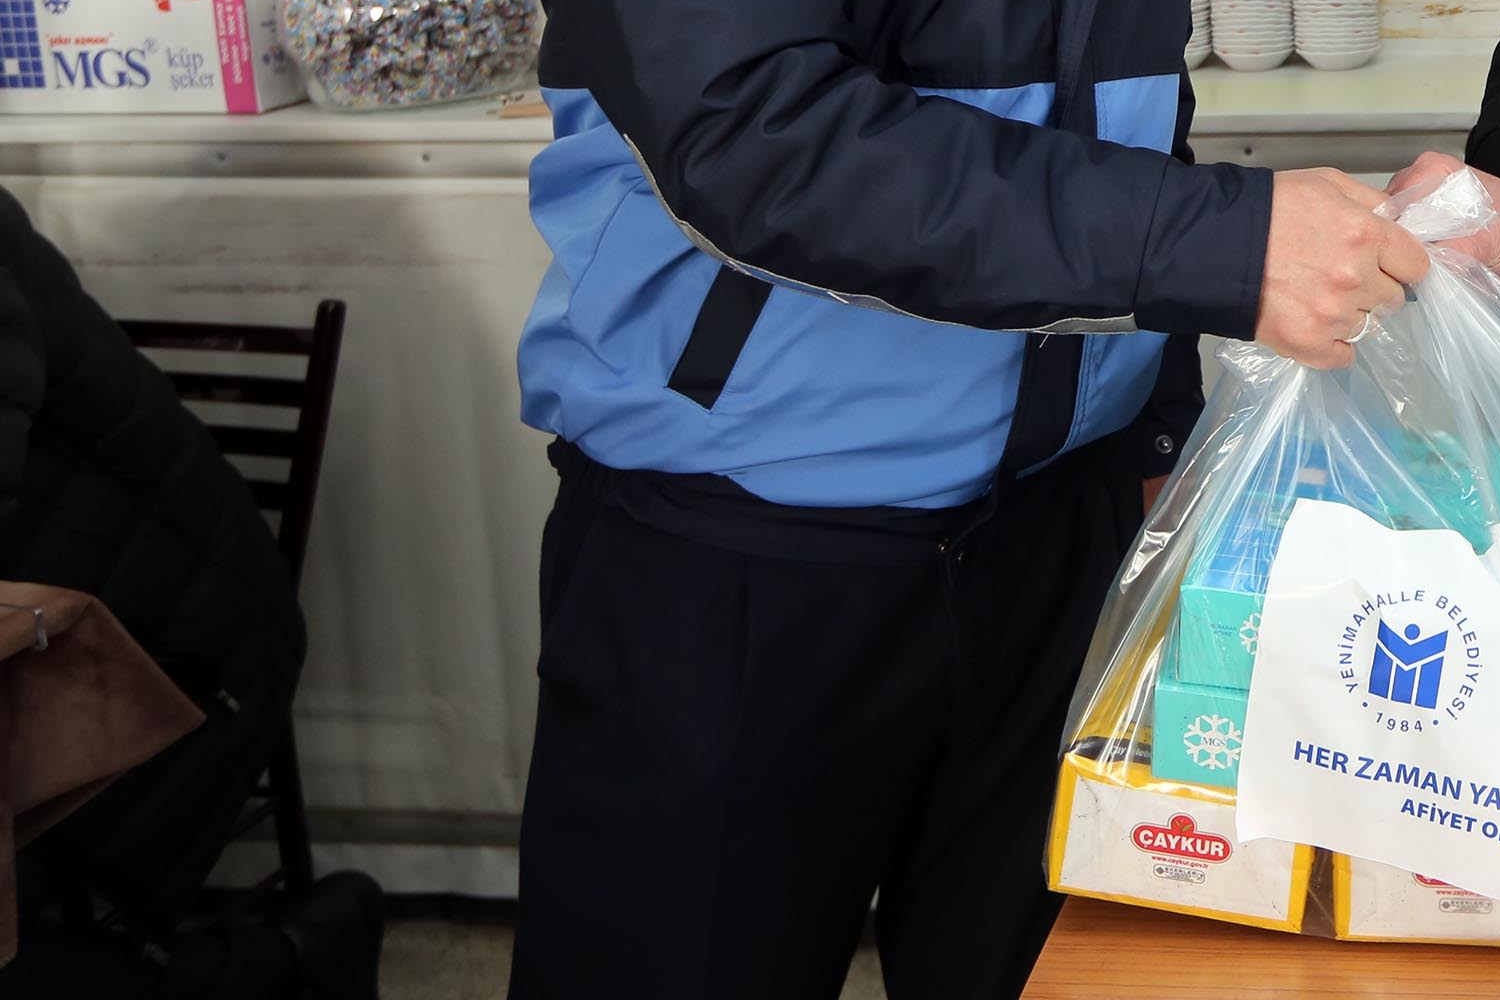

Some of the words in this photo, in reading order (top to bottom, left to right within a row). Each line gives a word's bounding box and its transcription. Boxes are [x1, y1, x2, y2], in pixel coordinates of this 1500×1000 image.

[168, 47, 204, 71] küp
[170, 68, 215, 91] şeker
[1338, 589, 1425, 694] YENİMAHALLE
[1435, 595, 1483, 721] BELEDİYESİ
[1375, 711, 1424, 732] 1984
[1202, 737, 1226, 747] MGS
[1294, 740, 1349, 774] HER
[1354, 756, 1463, 800] ZAMAN
[1400, 798, 1477, 832] AFİYET
[1139, 829, 1225, 857] ÇAYKUR
